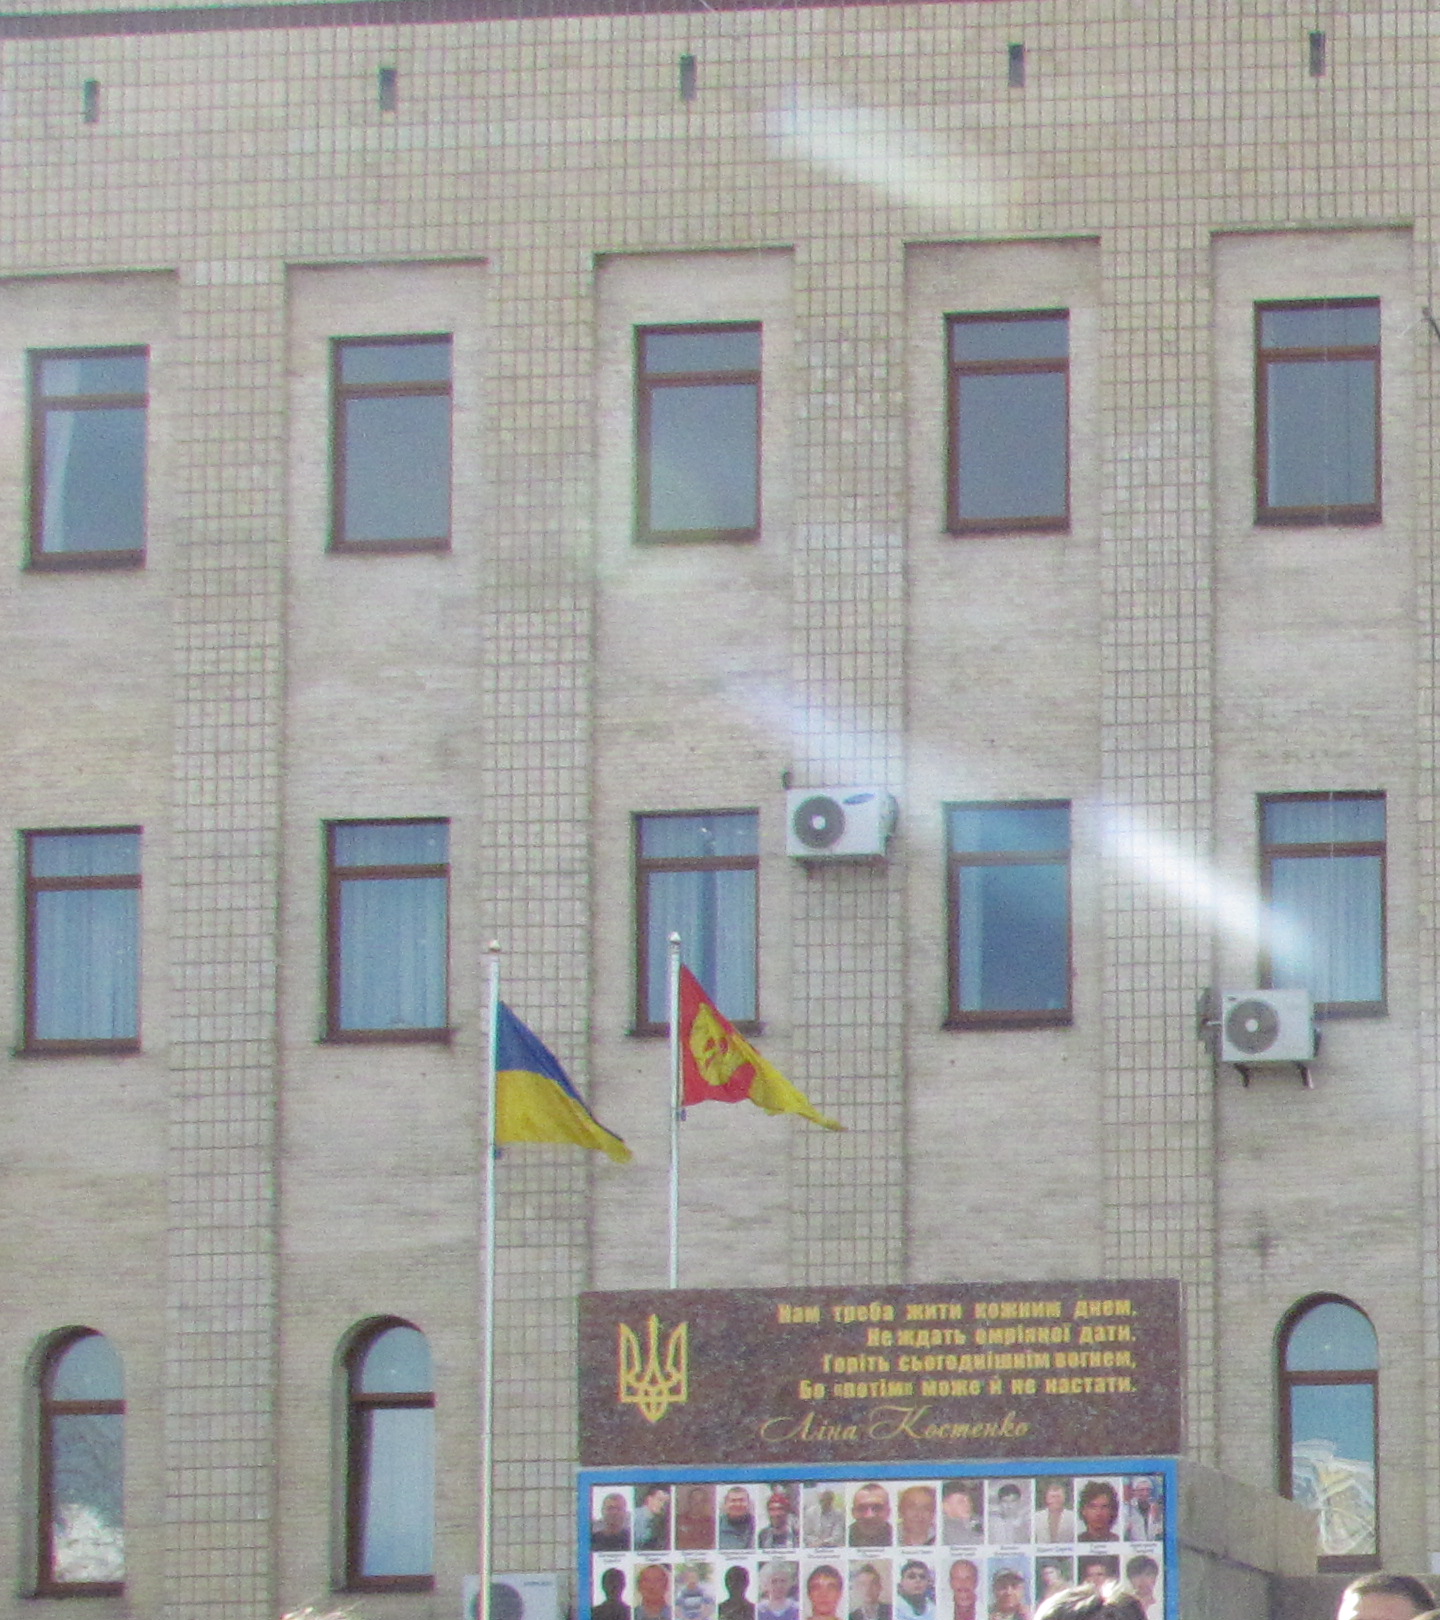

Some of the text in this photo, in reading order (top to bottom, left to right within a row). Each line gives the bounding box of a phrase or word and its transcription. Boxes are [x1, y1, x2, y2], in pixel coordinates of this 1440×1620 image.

[778, 1303, 821, 1325] Нам
[833, 1301, 895, 1324] треба
[906, 1303, 962, 1321] жити
[975, 1300, 1062, 1321] кожним
[866, 1327, 894, 1347] Не
[899, 1328, 966, 1349] ждать
[823, 1352, 892, 1375] Горіть
[799, 1379, 826, 1400] Бо
[921, 1378, 982, 1398] може
[1010, 1378, 1038, 1396] не
[760, 1404, 1031, 1444] Ліна Костенко
